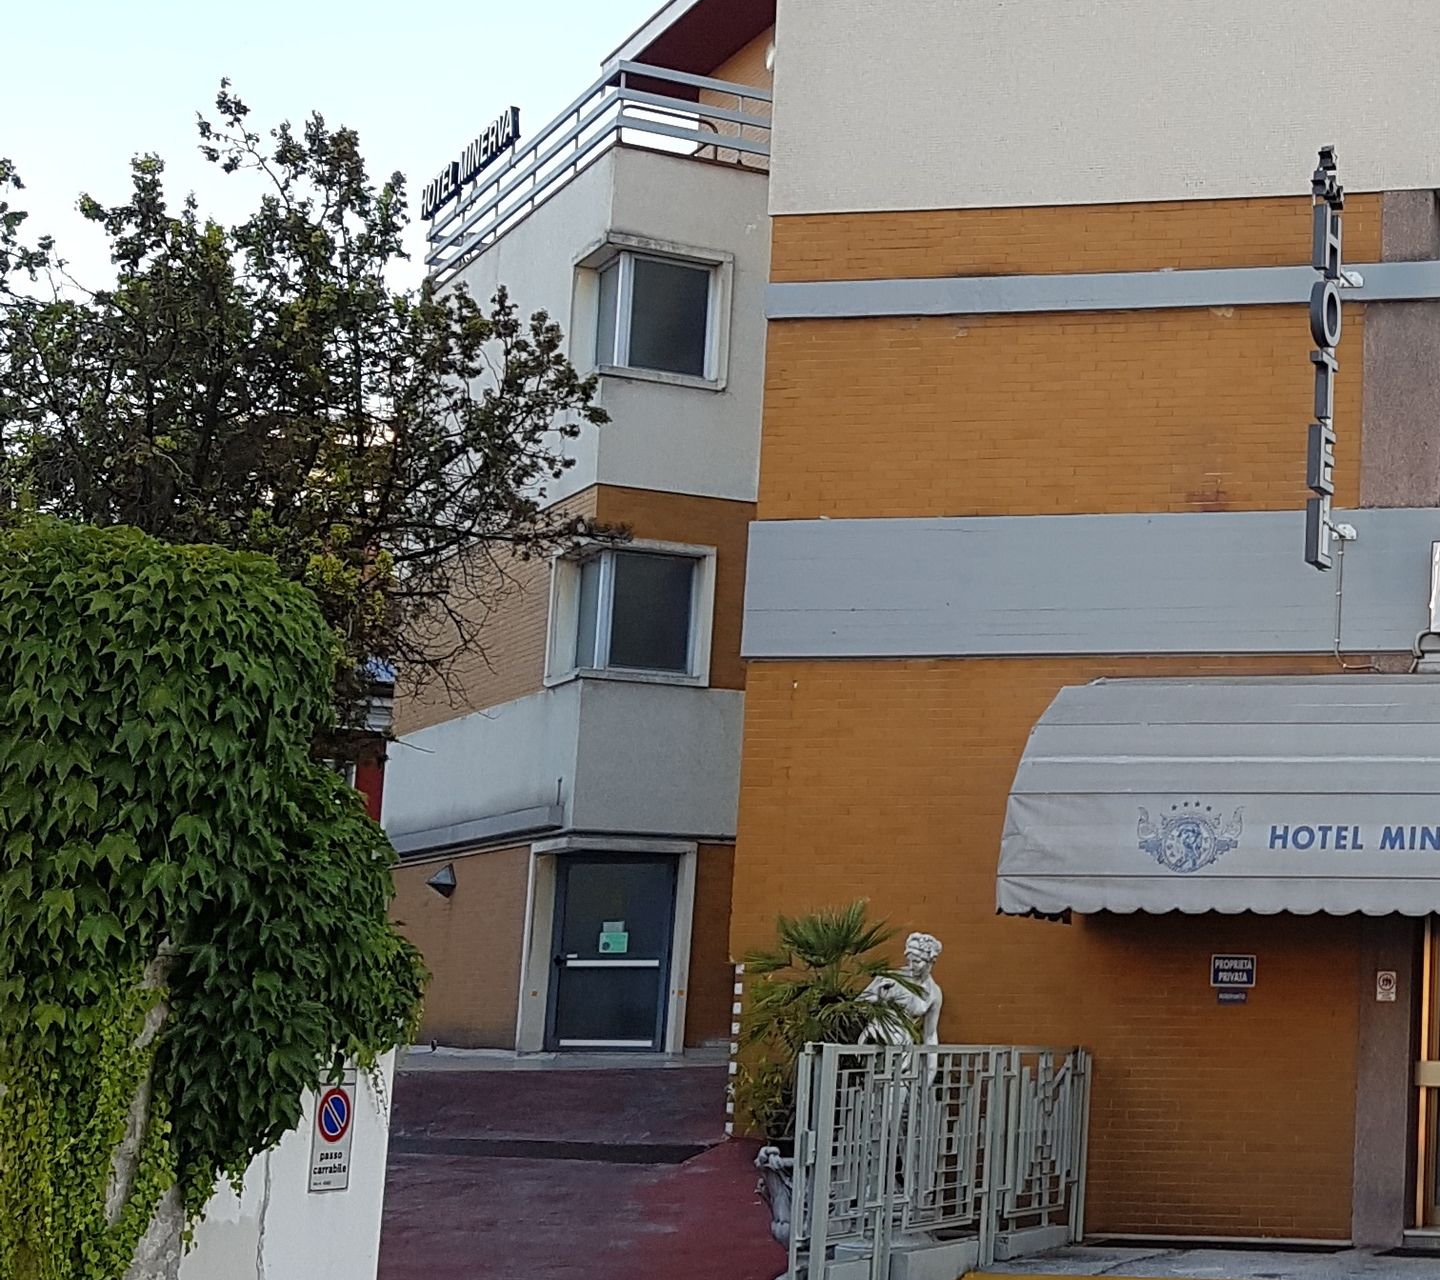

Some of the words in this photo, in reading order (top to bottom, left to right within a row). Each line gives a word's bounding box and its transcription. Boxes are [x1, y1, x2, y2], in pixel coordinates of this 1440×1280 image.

[421, 161, 460, 220] HOTEL
[458, 106, 520, 184] MINERVA
[1305, 202, 1342, 571] HOTEL
[1269, 824, 1364, 850] HOTEL
[1218, 971, 1248, 982] PRIVATA
[319, 1151, 343, 1162] passo
[312, 1163, 347, 1175] carrabile
